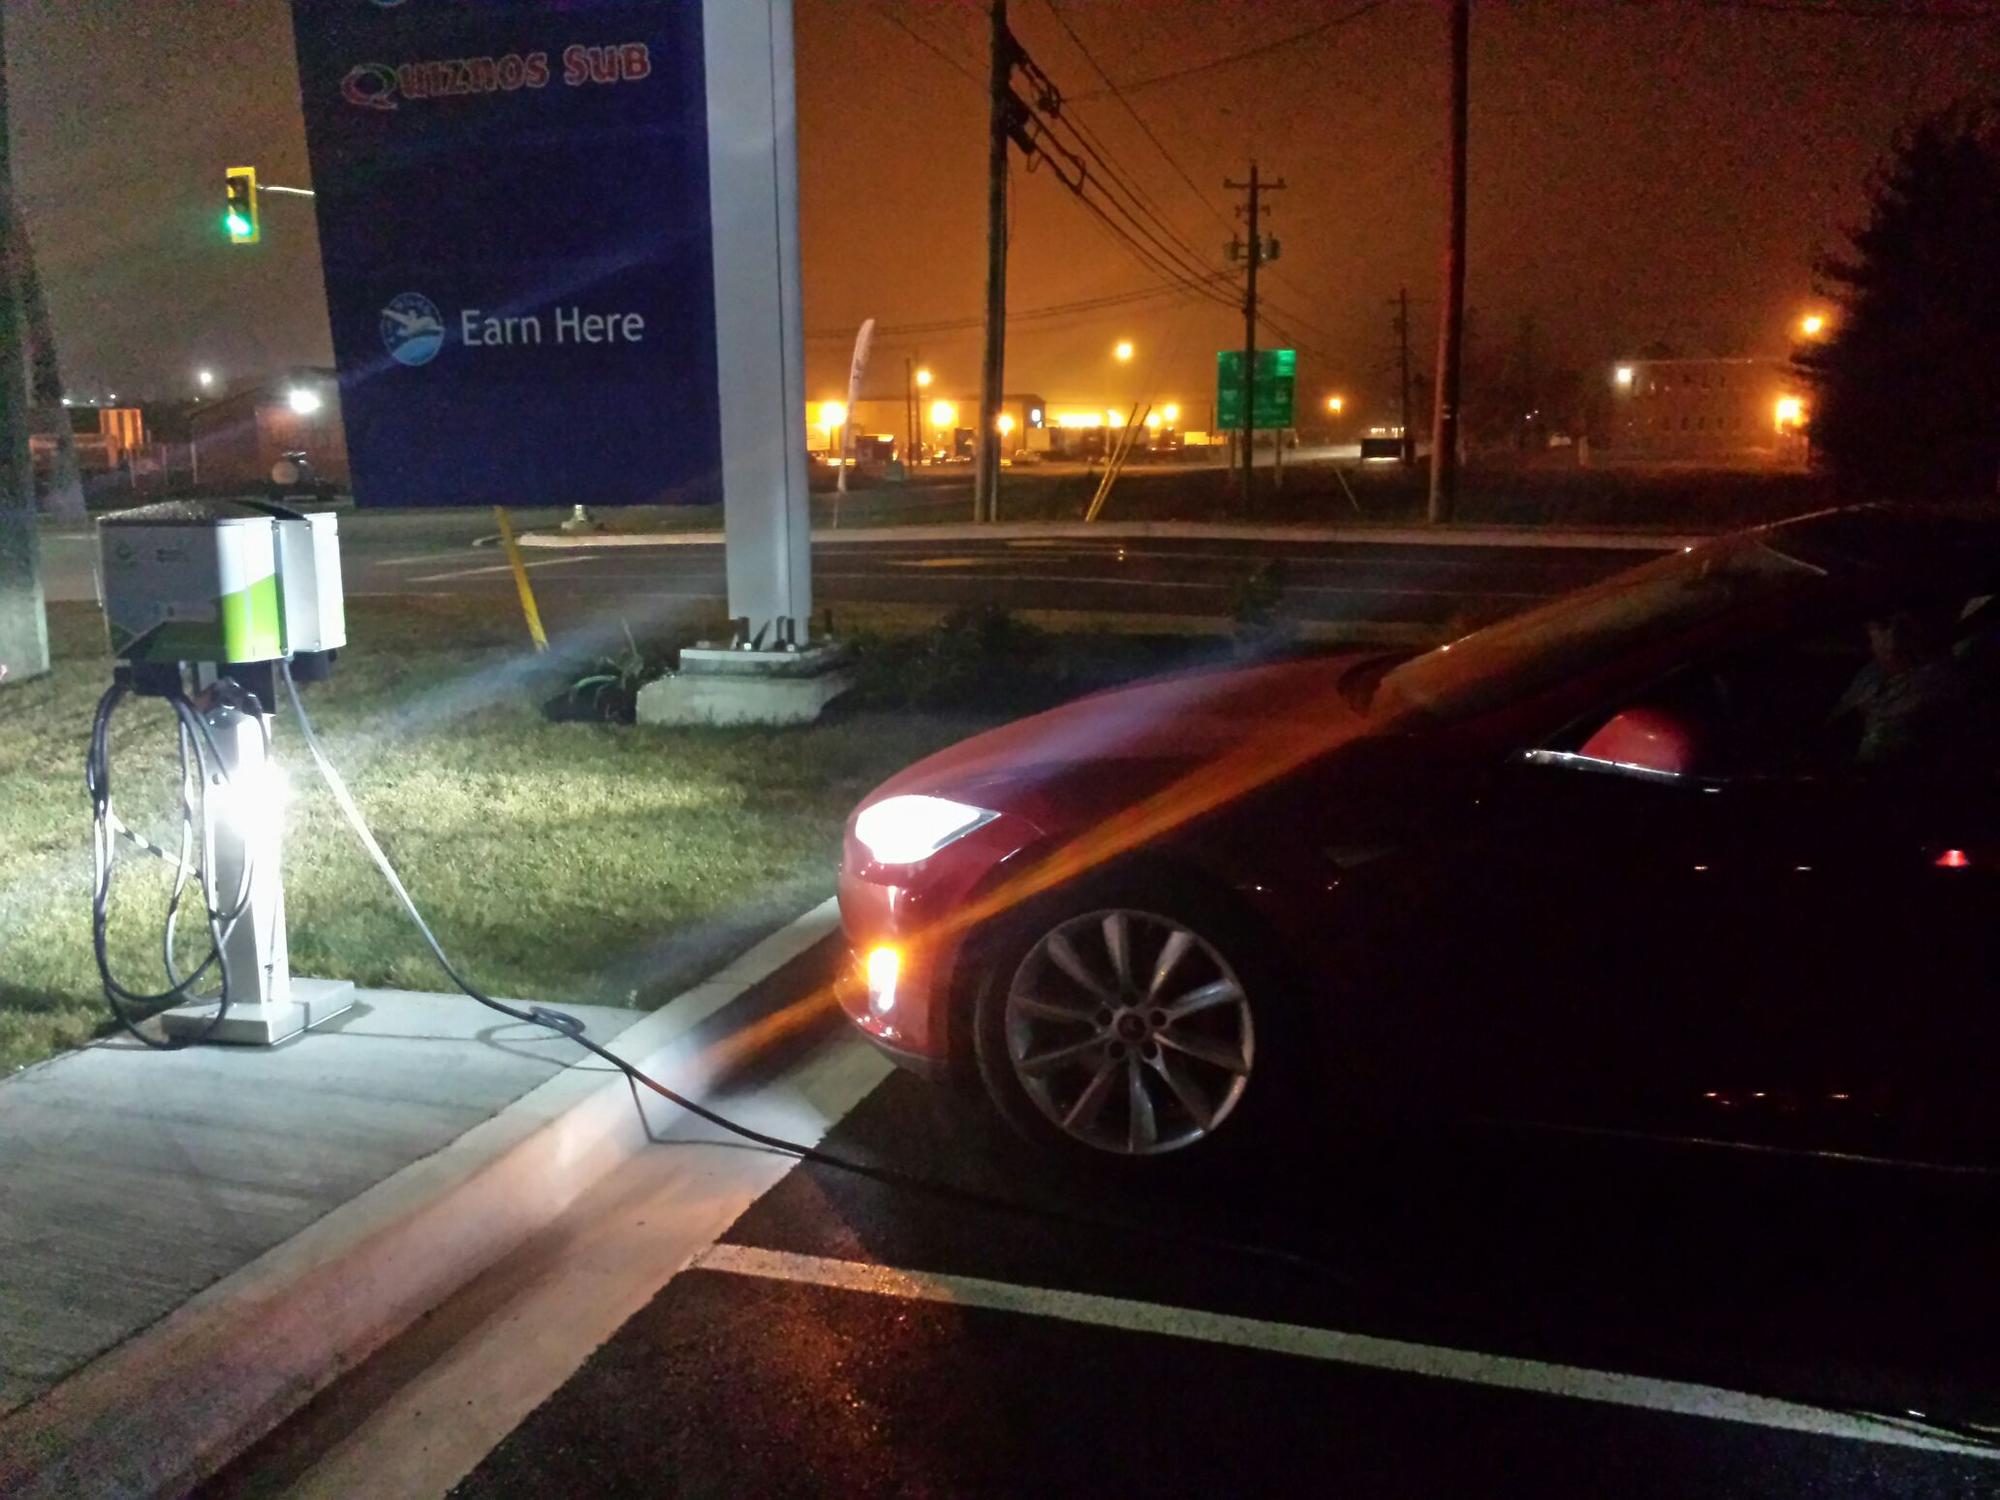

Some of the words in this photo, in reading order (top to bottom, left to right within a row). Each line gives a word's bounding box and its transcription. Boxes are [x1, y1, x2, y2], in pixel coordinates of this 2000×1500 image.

[563, 42, 651, 86] SUB
[461, 308, 542, 346] Earn
[555, 306, 646, 344] Here
